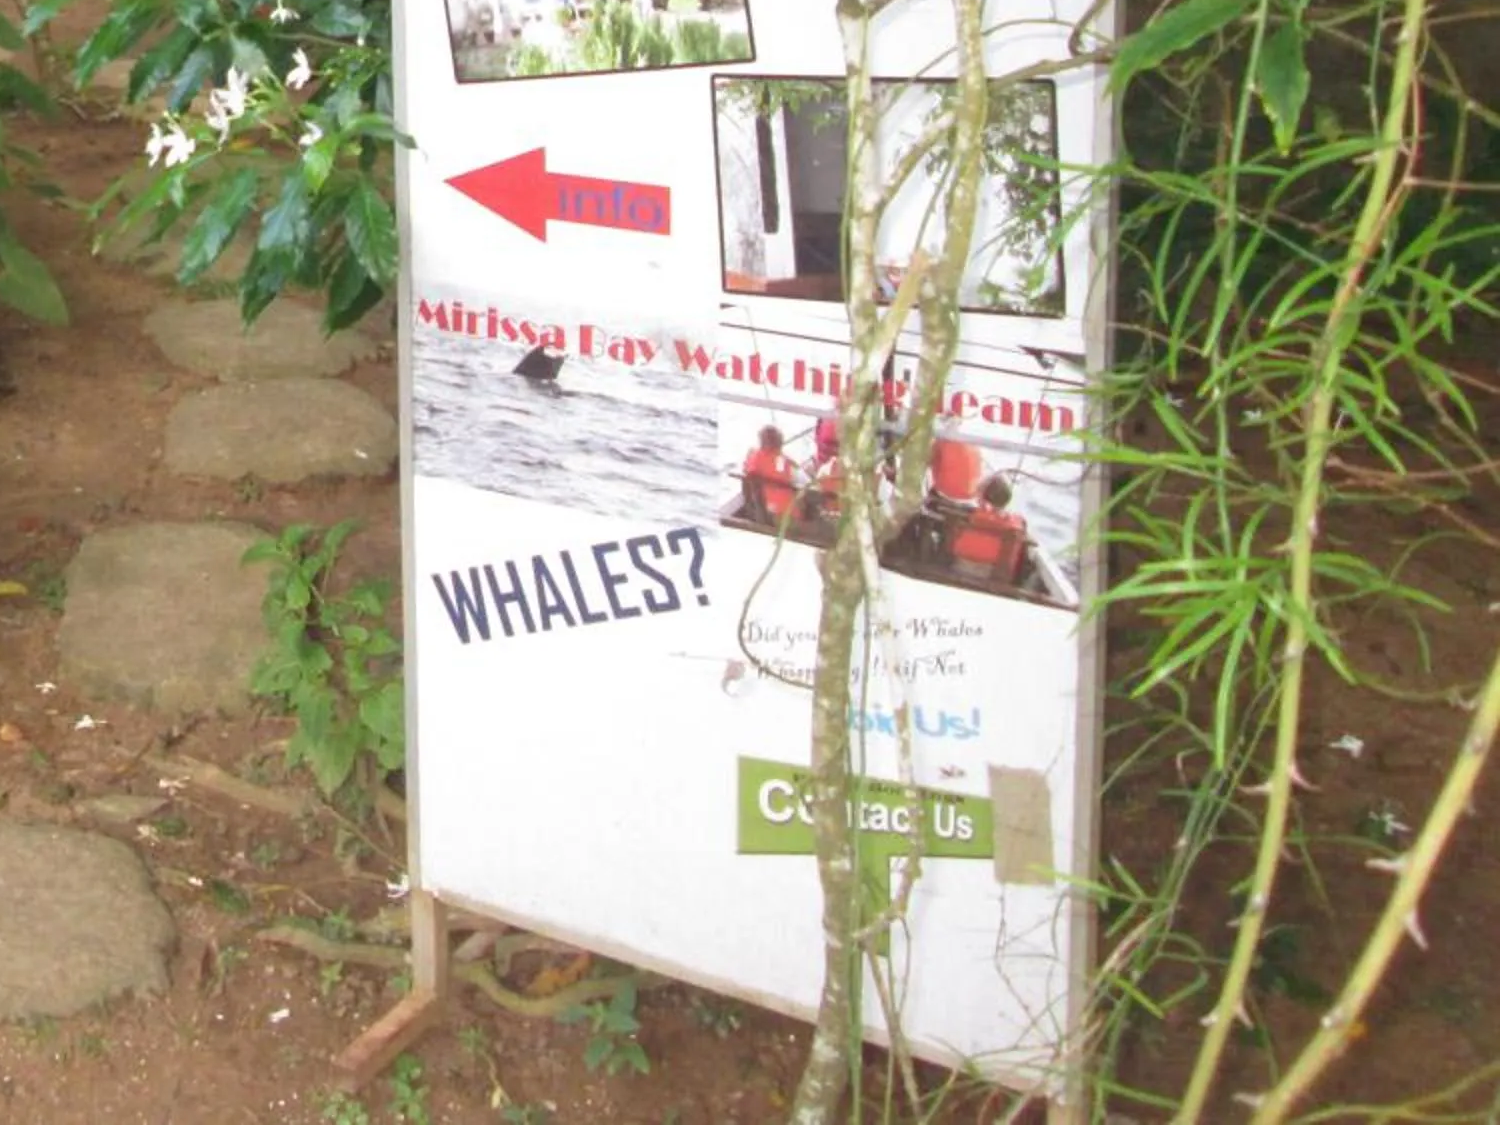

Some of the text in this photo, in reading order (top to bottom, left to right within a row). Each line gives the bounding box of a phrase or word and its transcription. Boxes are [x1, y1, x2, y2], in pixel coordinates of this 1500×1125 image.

[558, 184, 665, 231] info
[417, 299, 566, 355] Mirissa
[674, 338, 907, 415] Watchig
[432, 528, 711, 645] WHALES?
[913, 704, 981, 740] Us!
[933, 803, 974, 841] Us
